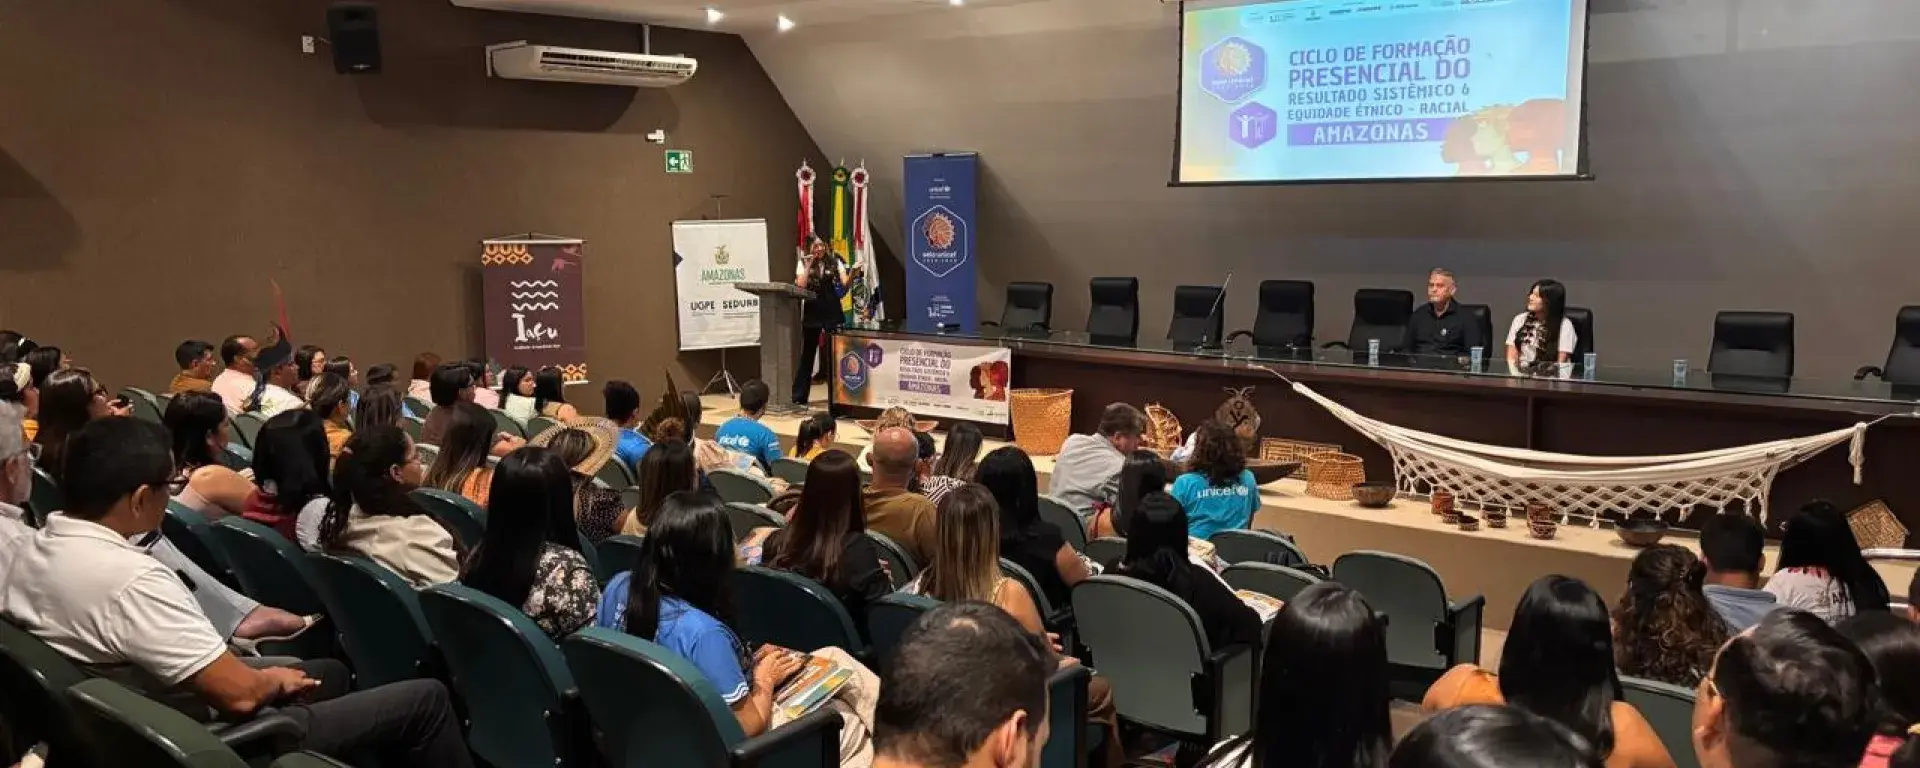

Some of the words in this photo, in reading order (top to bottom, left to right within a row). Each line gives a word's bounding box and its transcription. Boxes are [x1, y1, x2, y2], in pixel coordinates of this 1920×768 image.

[1289, 48, 1337, 66] CICLO
[1343, 45, 1366, 62] DE
[1372, 34, 1470, 62] FORMAÇÃO
[1289, 61, 1426, 89] PRESENCIAL
[1436, 57, 1471, 80] DO
[1288, 88, 1367, 106] RESULTADO
[1373, 83, 1455, 101] SISTÊMICO
[1461, 83, 1470, 96] 6
[1287, 107, 1350, 121] EQUIDADE
[1355, 103, 1403, 117] ÉTNICO
[1419, 102, 1469, 115] RACIAL
[1313, 122, 1429, 145] AMAZONAS
[701, 268, 746, 283] AMAZONAS
[1197, 484, 1236, 498] unicef
